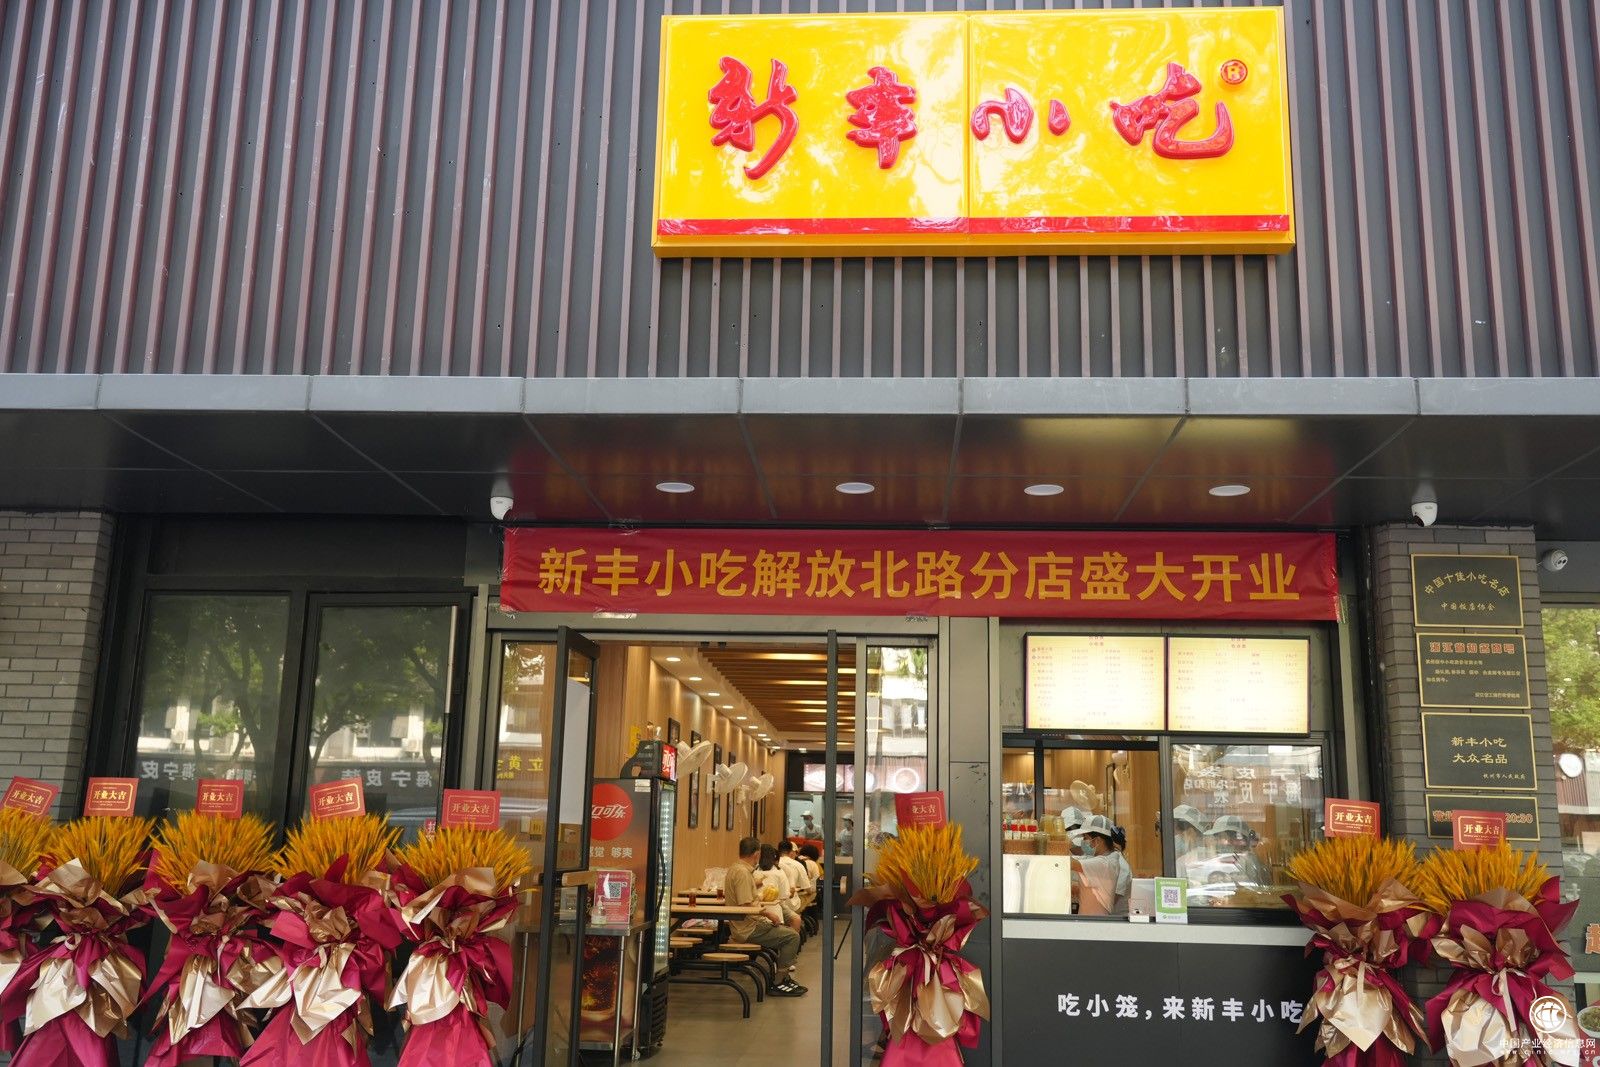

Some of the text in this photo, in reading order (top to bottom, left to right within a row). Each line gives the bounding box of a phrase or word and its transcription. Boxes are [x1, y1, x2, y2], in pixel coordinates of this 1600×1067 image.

[538, 547, 1300, 602] 新丰小吃解放北路分店盛大开业
[1424, 571, 1510, 597] 中国十佳小吃名店
[1451, 736, 1507, 748] 新丰小吃
[1453, 753, 1508, 764] 大众名品
[12, 790, 45, 805] 开业大吉
[93, 790, 127, 800] 开业大吉
[202, 792, 233, 802] 开业大吉
[318, 791, 354, 807] 开业大吉
[452, 803, 490, 814] 开业大吉
[592, 803, 629, 819] 口可乐
[1335, 811, 1372, 825] 开业大吉
[1463, 823, 1500, 836] 开业大吉
